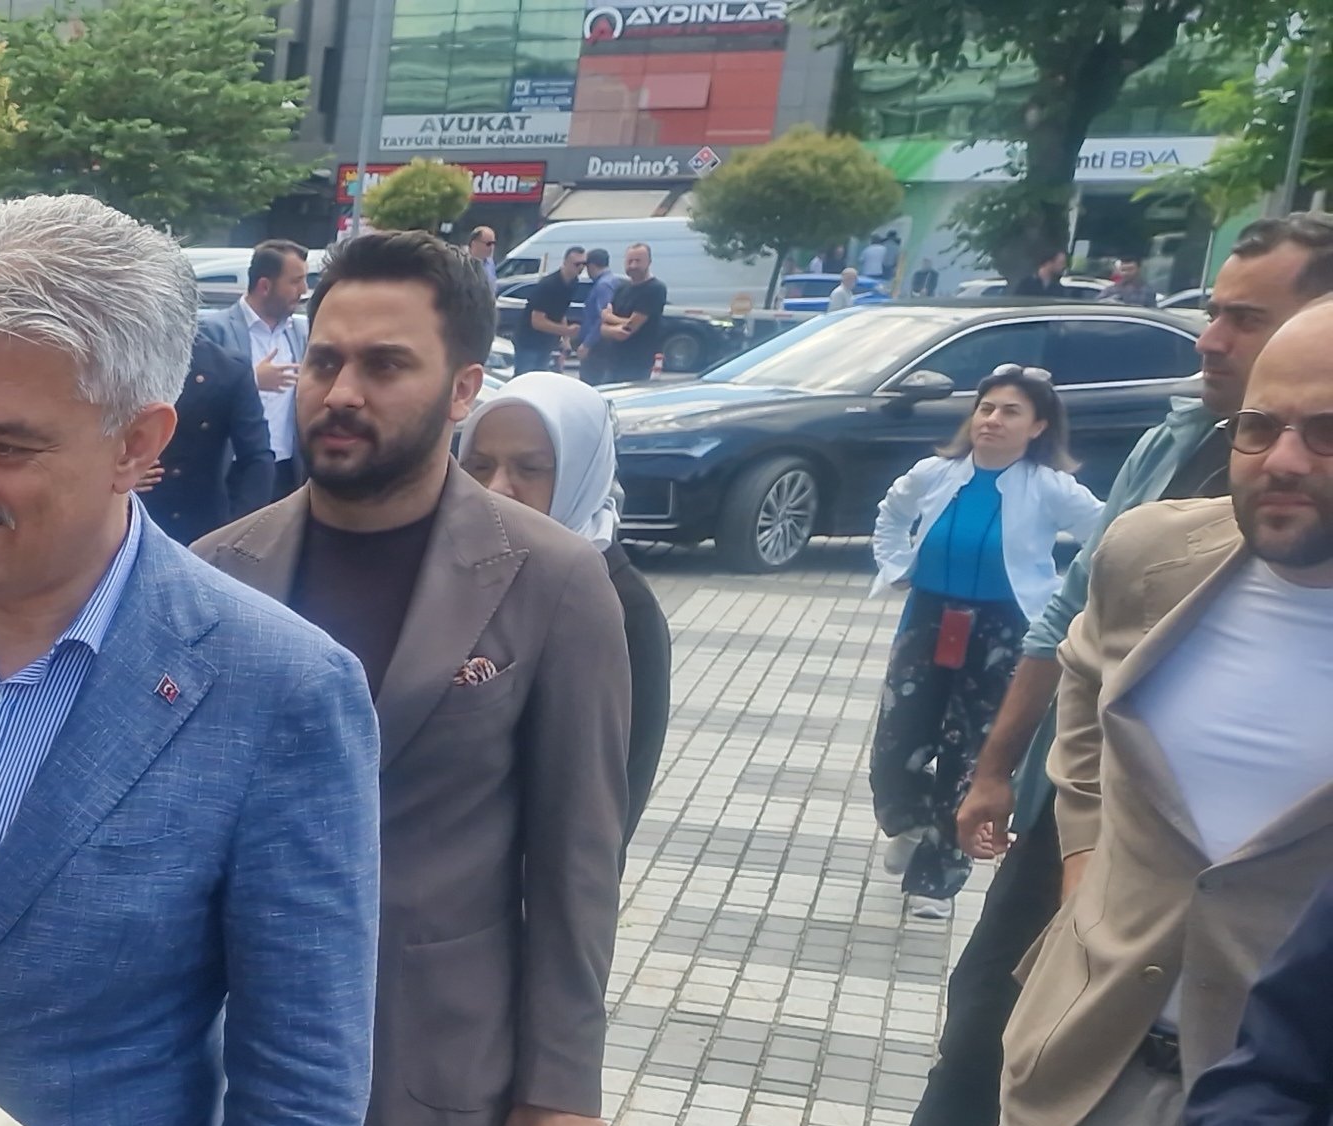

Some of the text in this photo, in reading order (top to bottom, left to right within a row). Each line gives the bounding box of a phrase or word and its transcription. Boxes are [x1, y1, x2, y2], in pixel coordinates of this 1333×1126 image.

[625, 2, 787, 25] AYDINLAR
[419, 115, 532, 132] AVUKAT
[382, 136, 433, 147] TAYFUR
[587, 154, 680, 176] Domino's
[1076, 148, 1180, 169] nti BBVA
[467, 170, 518, 194] icken
